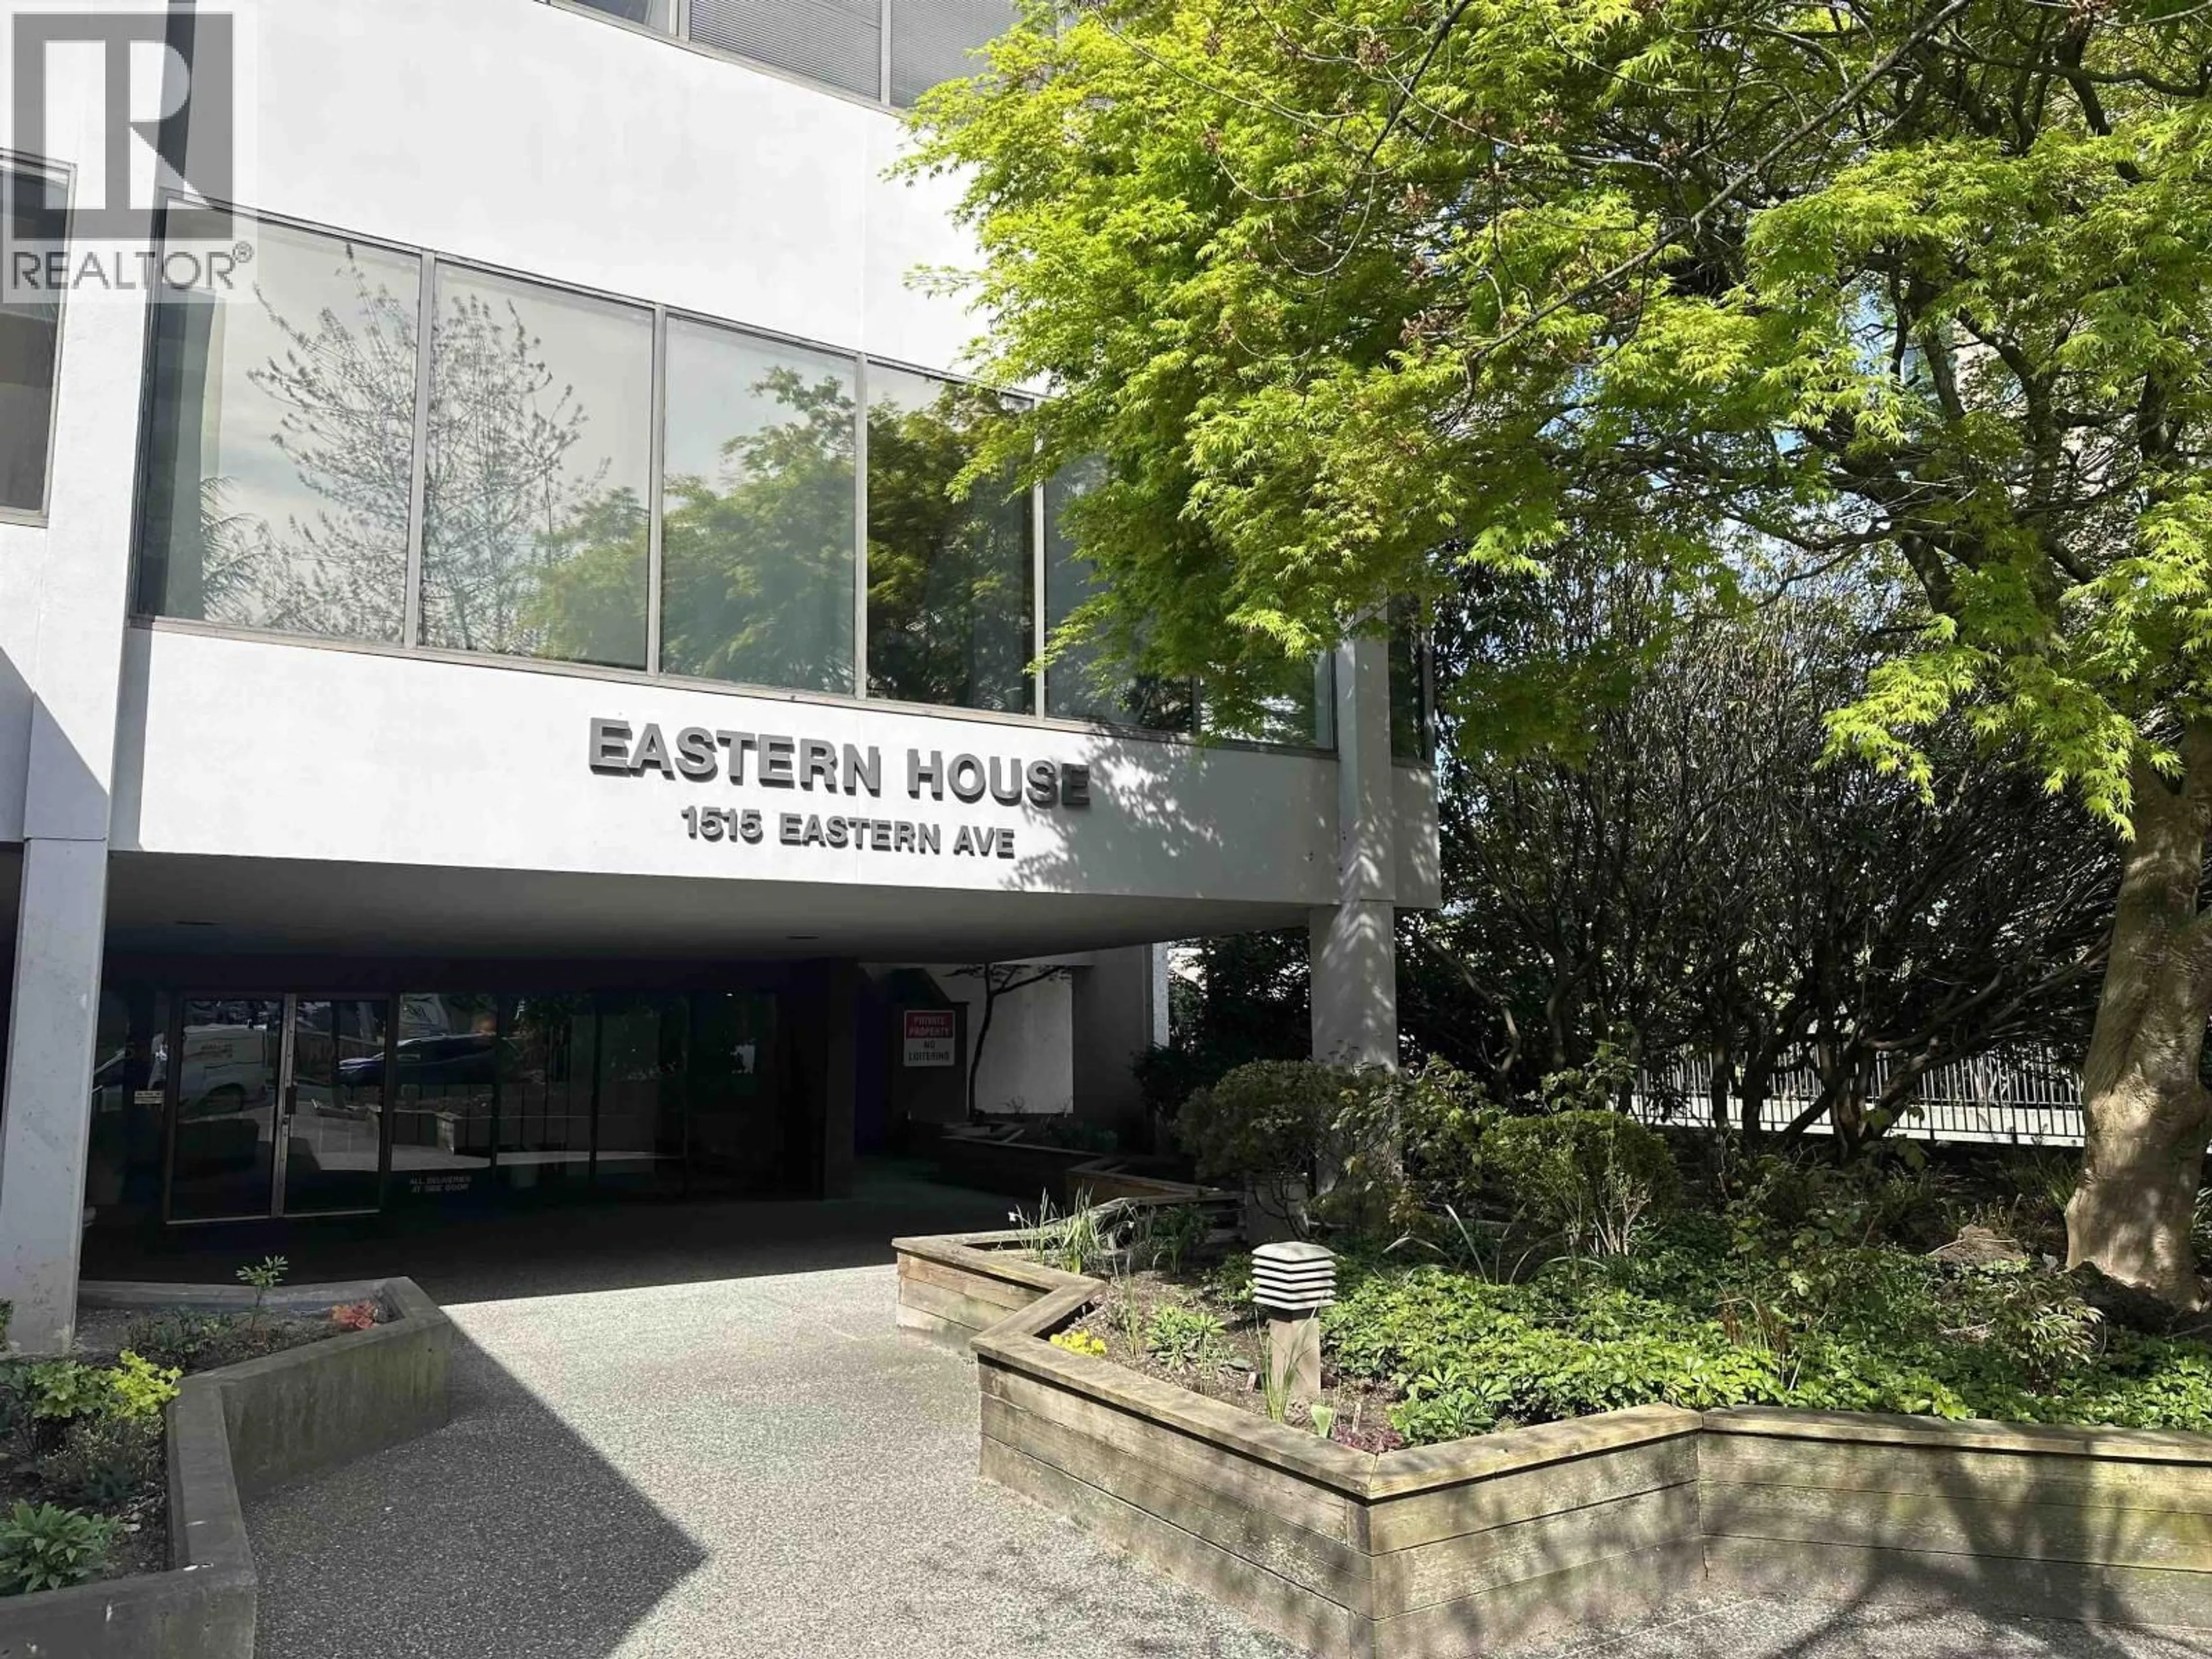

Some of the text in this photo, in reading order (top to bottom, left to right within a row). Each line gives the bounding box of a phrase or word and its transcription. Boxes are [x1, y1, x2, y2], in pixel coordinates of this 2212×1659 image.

[589, 717, 1091, 811] EASTERN HOUSE
[681, 806, 1016, 859] 1515 EASTERN AVE
[914, 1017, 945, 1025] PRIVATE
[908, 1026, 949, 1037] PROPERTY
[923, 1040, 935, 1048] NO
[908, 1051, 950, 1061] LOITERING
